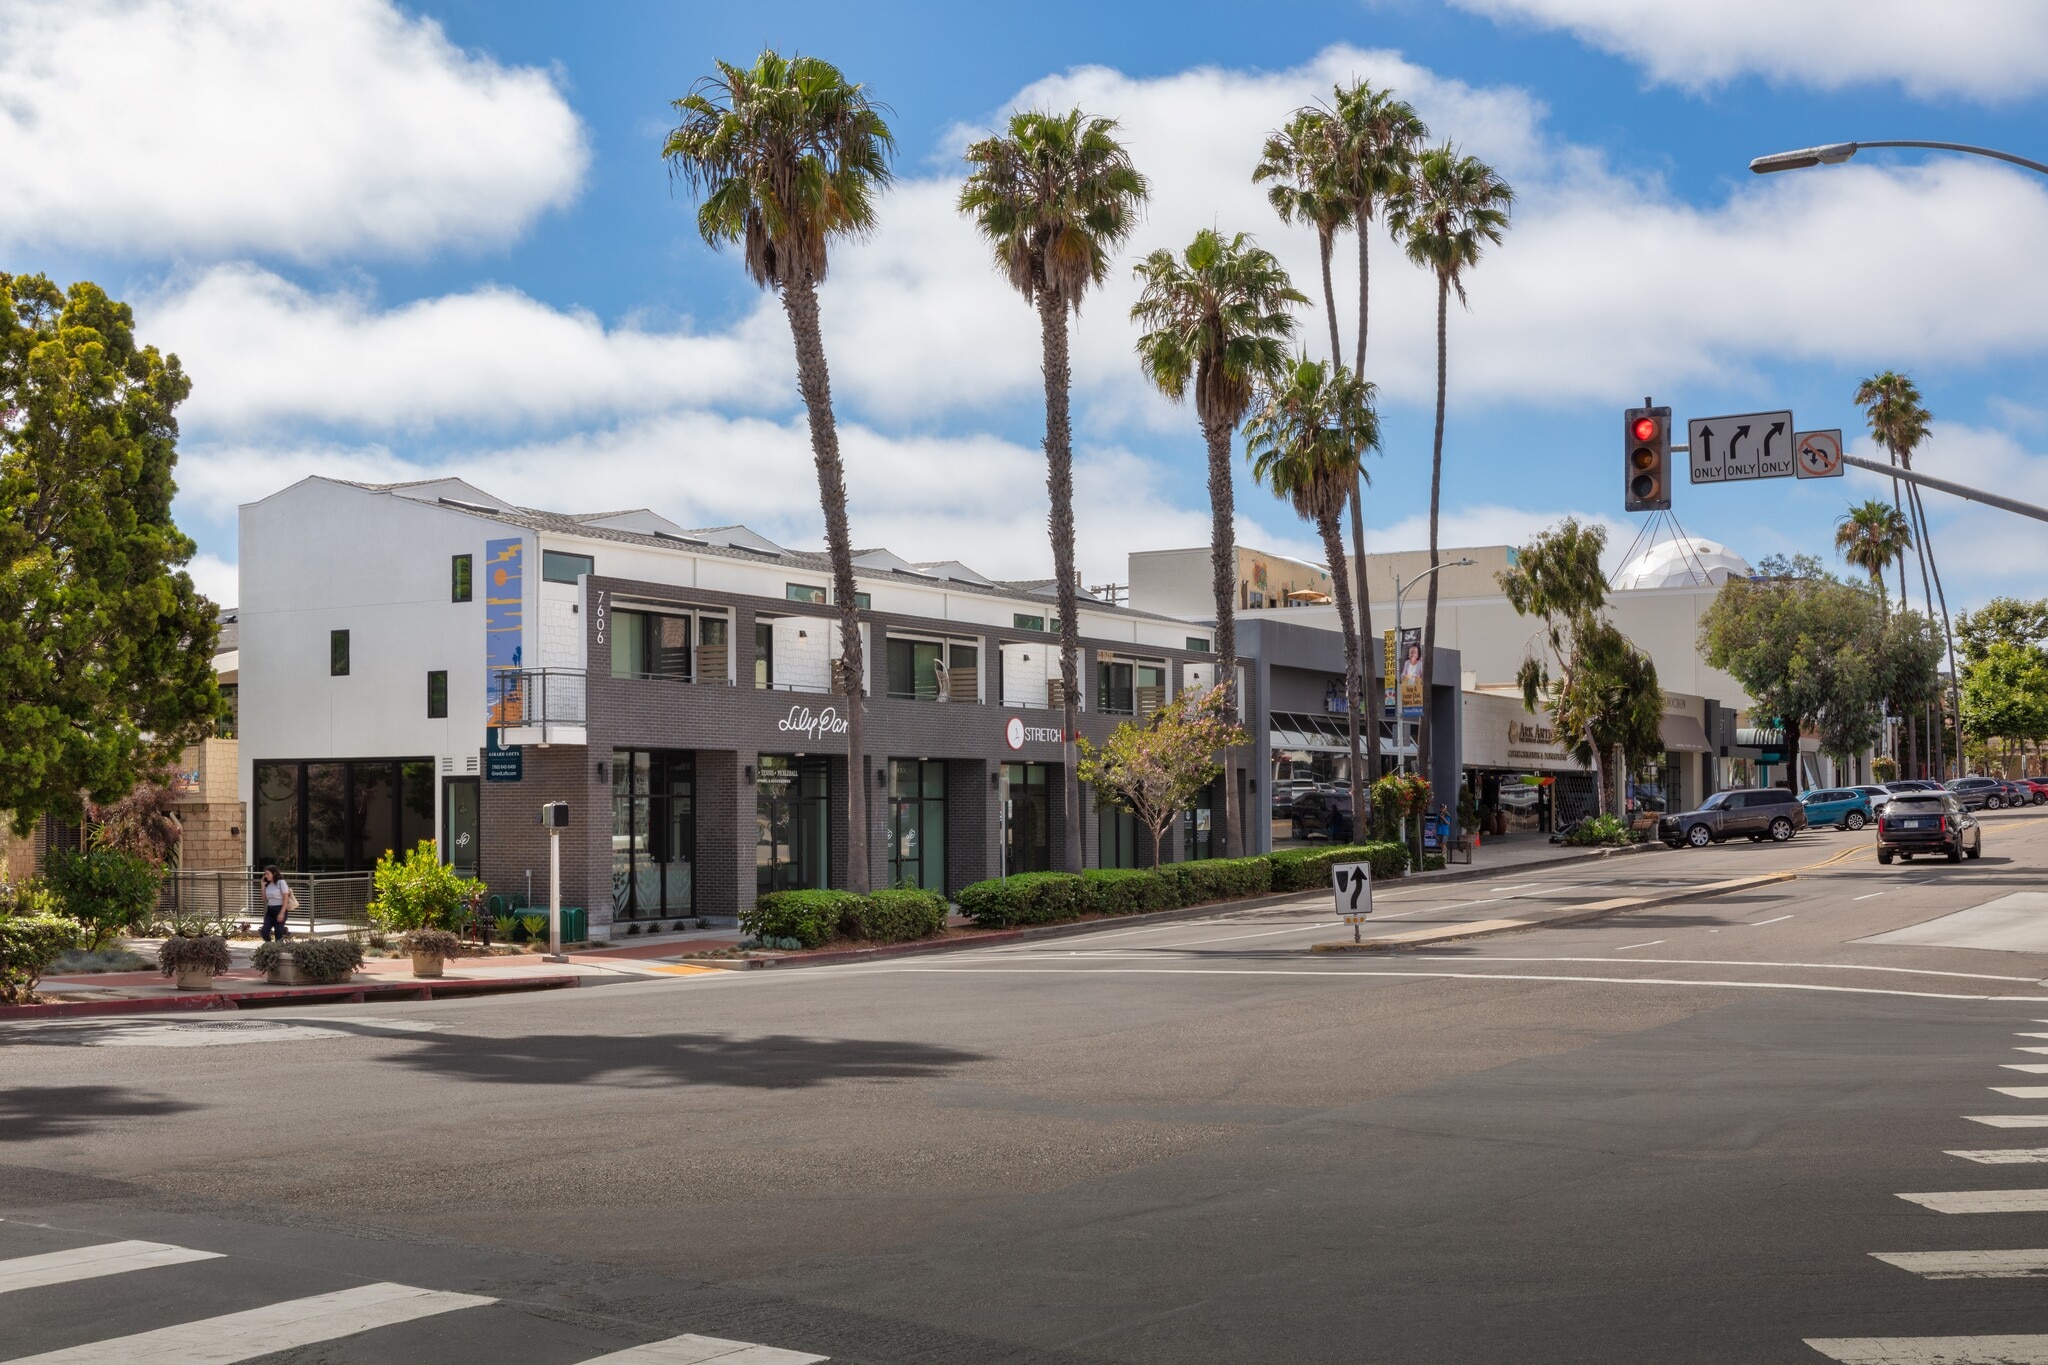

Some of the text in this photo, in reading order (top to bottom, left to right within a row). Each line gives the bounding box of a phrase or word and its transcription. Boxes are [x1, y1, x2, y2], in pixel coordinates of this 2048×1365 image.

[1694, 461, 1790, 478] ONLY ONLY ONLY
[778, 705, 818, 740] Lily
[1024, 727, 1062, 743] STRETCH
[777, 769, 798, 777] PICKLEBALL
